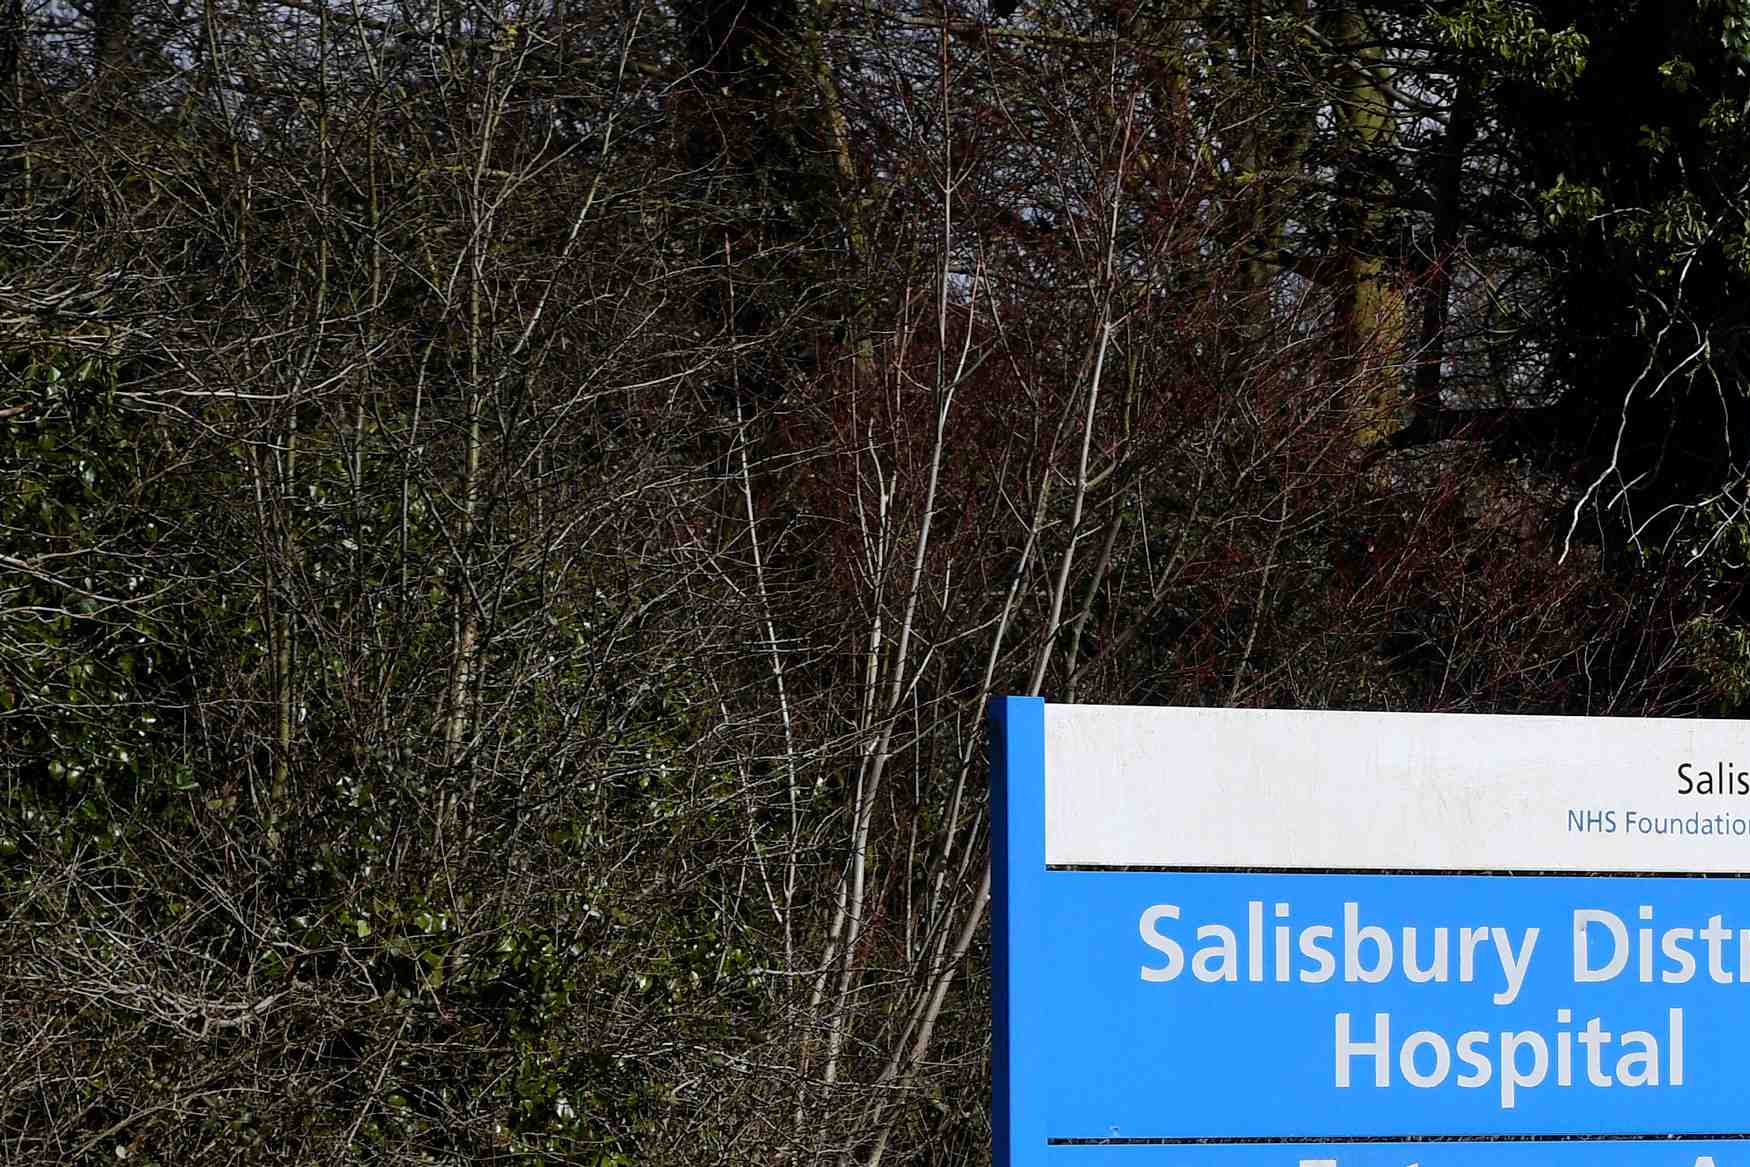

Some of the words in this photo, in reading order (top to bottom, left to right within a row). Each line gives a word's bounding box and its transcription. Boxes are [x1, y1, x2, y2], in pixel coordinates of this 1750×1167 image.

[1567, 810, 1617, 834] NHS
[1138, 901, 1540, 1006] Salisbury
[1334, 1007, 1684, 1110] Hospital
